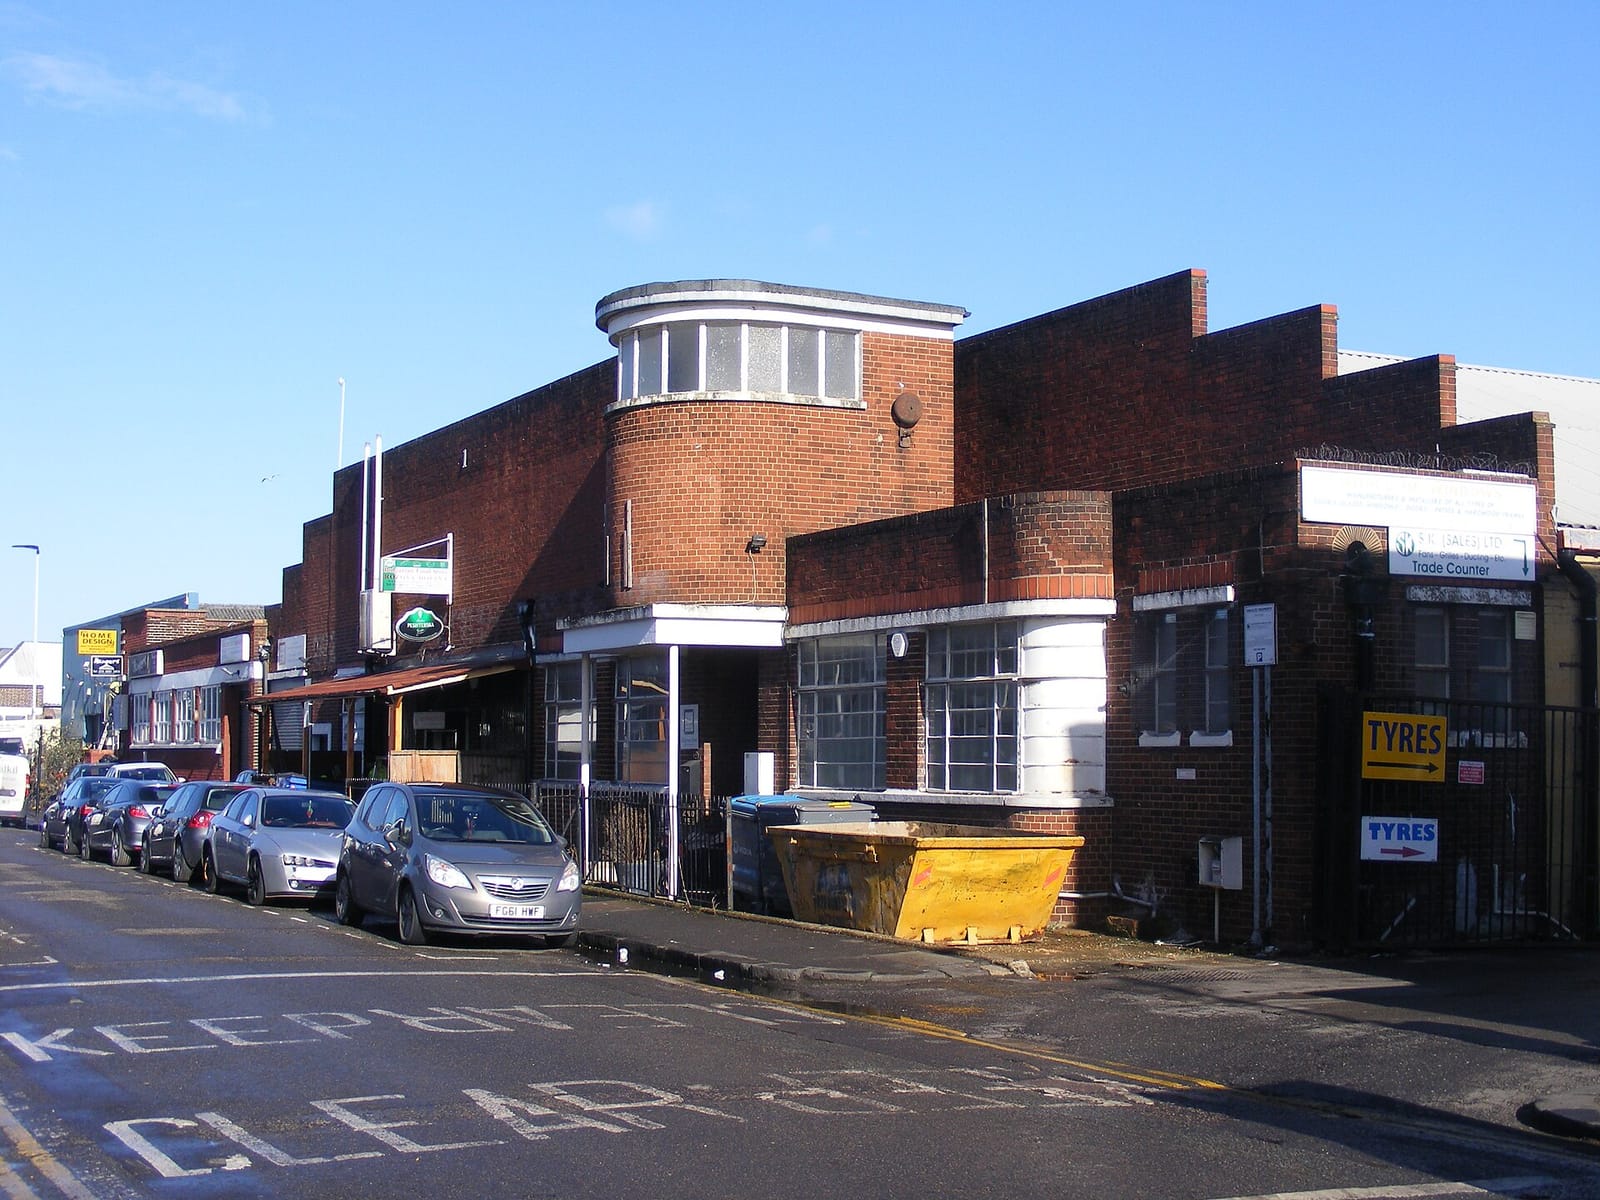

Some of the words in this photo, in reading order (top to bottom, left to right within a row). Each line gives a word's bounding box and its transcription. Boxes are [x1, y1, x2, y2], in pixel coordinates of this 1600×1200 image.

[1484, 536, 1503, 549] LTD
[1412, 561, 1443, 574] Trade
[1446, 562, 1490, 576] Counter
[1368, 720, 1441, 755] TYRES
[1369, 823, 1435, 841] TYRES
[522, 906, 540, 916] HWF
[0, 1011, 371, 1063] KEEP
[103, 1078, 744, 1178] CLEAR
